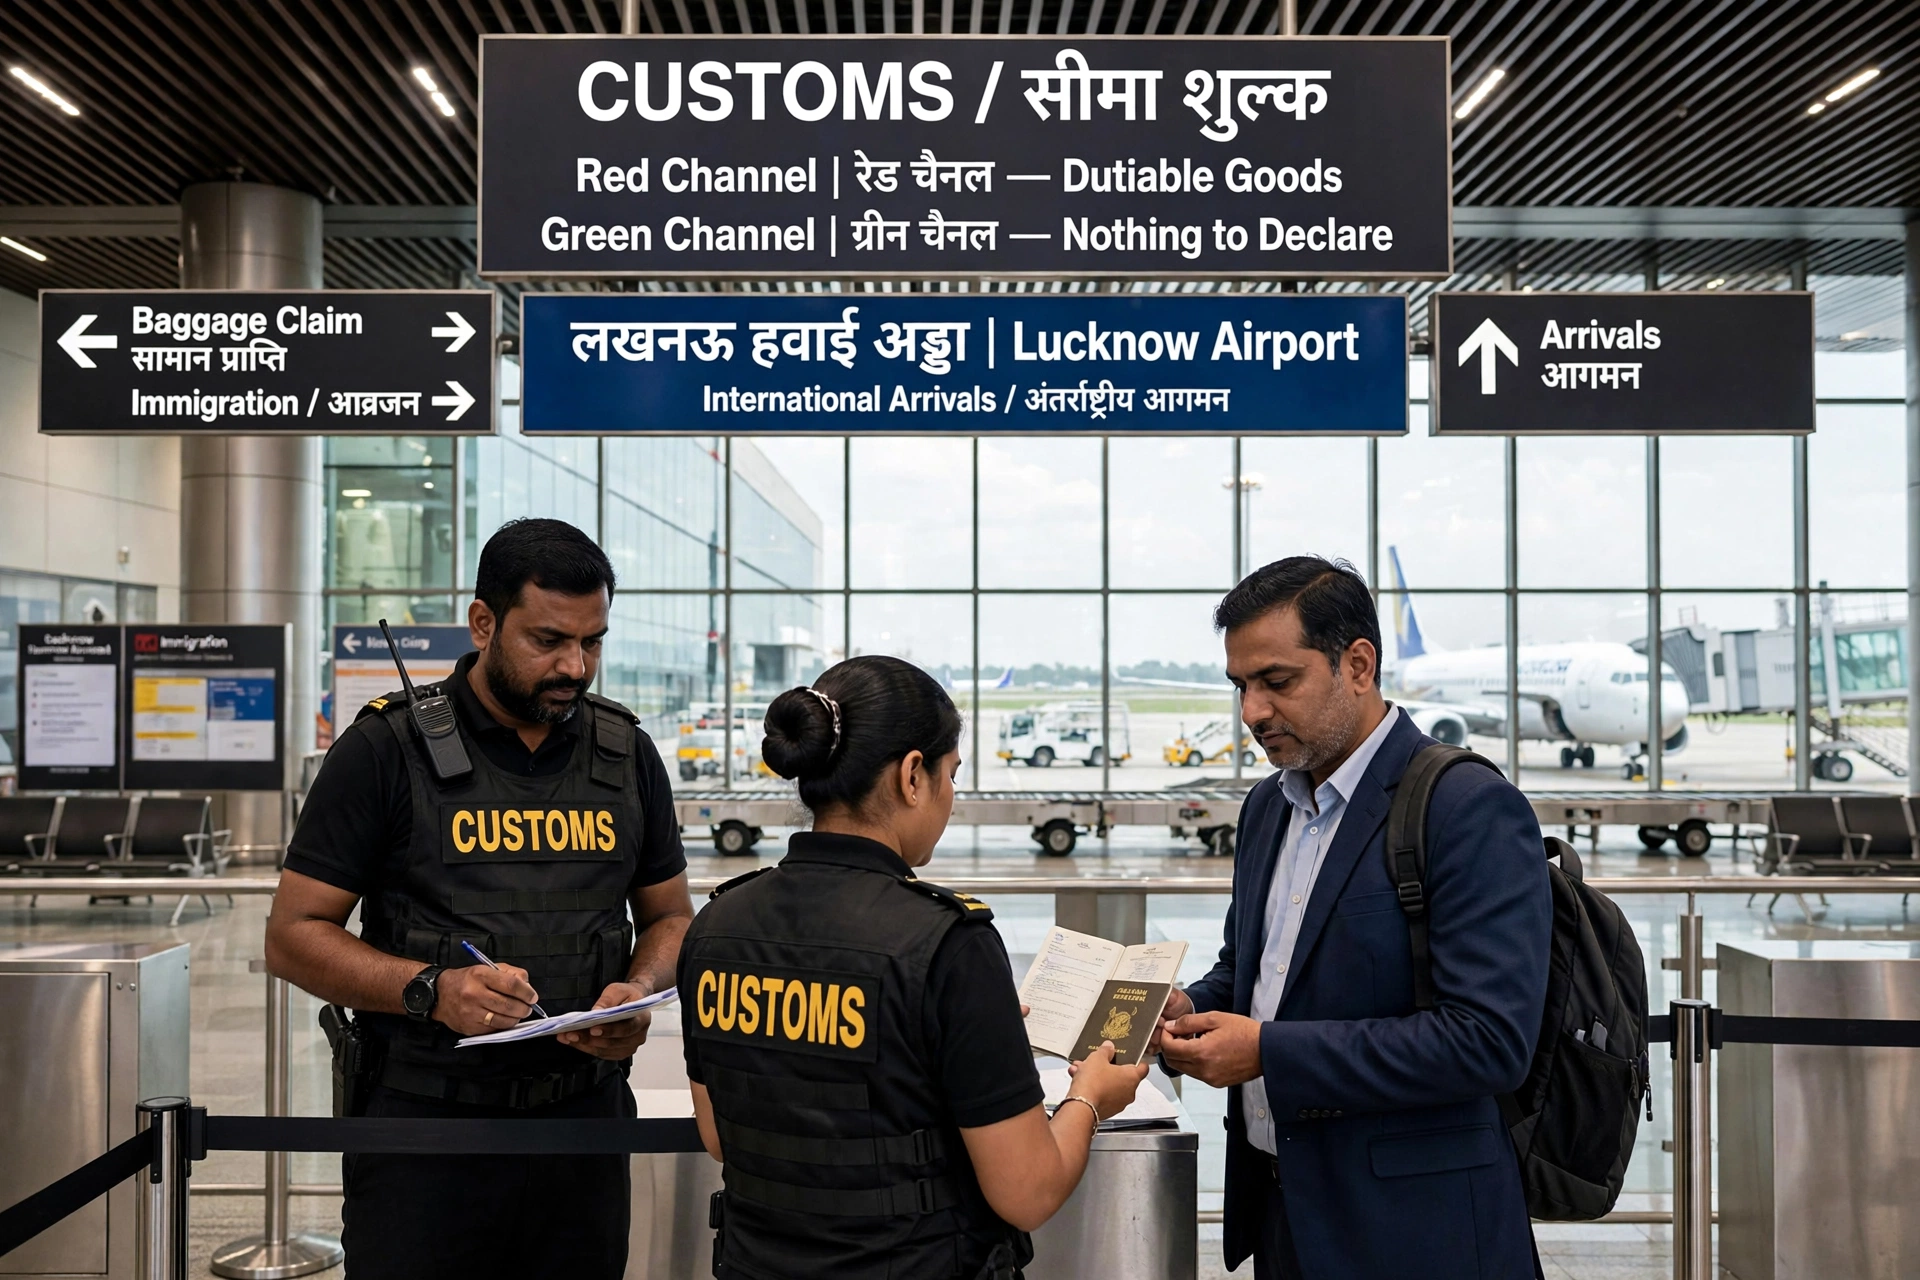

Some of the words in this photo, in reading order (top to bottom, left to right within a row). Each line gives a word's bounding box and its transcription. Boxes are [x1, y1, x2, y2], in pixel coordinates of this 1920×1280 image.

[578, 61, 953, 121] CUSTOMS
[1021, 48, 1163, 121] सीमा
[1183, 69, 1331, 142] शुल्क
[577, 158, 648, 192] Red
[662, 157, 816, 193] Channel
[854, 149, 901, 192] रेड
[910, 149, 995, 192] चैनल
[1064, 158, 1214, 192] Dutiable
[1225, 158, 1342, 193] Goods
[542, 216, 651, 251] Green
[664, 216, 814, 251] Channel
[850, 209, 910, 251] ग्रीन
[919, 209, 999, 251] चैनल
[1064, 217, 1201, 259] Nothing
[1212, 219, 1248, 251] to
[1260, 217, 1393, 251] Declare
[132, 305, 267, 341] Baggage
[276, 305, 363, 334] Claim
[570, 322, 737, 362] लखनऊ
[749, 306, 859, 369] हवाई
[873, 322, 970, 375] अड्डा
[1015, 321, 1199, 361] Lucknow
[1211, 320, 1359, 370] Airport
[1540, 319, 1661, 349] Arrivals
[131, 347, 213, 372] सामान
[220, 338, 288, 372] प्राप्ति
[1541, 362, 1642, 389] आगमन
[132, 388, 298, 422] Immigration
[328, 392, 422, 416] आव्रजन
[704, 385, 880, 412] International
[889, 385, 996, 412] Arrivals
[1144, 388, 1230, 412] आगमन
[452, 810, 616, 853] CUSTOMS
[697, 969, 866, 1049] CUSTOMS
